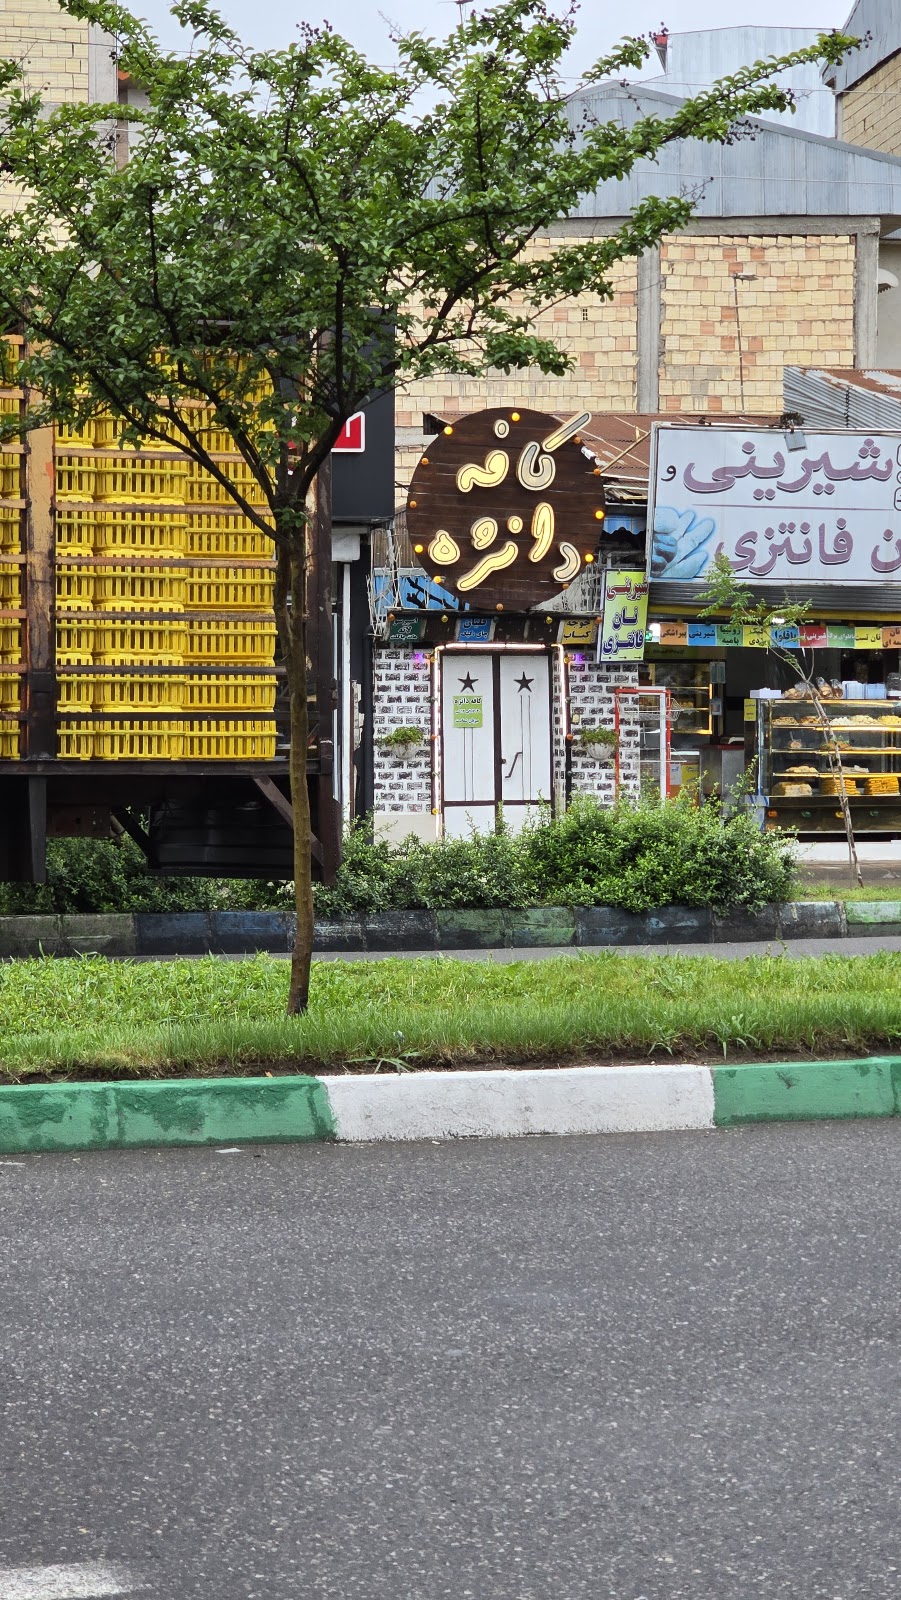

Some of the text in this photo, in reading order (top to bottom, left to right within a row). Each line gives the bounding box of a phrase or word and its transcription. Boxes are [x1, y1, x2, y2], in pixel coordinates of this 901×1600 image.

[456, 410, 593, 493] کافه
[661, 439, 894, 500] شیرینی و
[714, 518, 854, 576] فانتزی
[606, 574, 649, 600] شیرینی
[566, 620, 591, 629] جوجه
[612, 607, 638, 630] نان
[563, 630, 591, 641] کباب
[660, 629, 687, 639] پیراشکی
[689, 630, 715, 638] شیرینی
[774, 630, 797, 642] باقلوا
[870, 633, 881, 642] نان
[602, 630, 645, 656] فانتزی
[722, 637, 739, 645] بامیه
